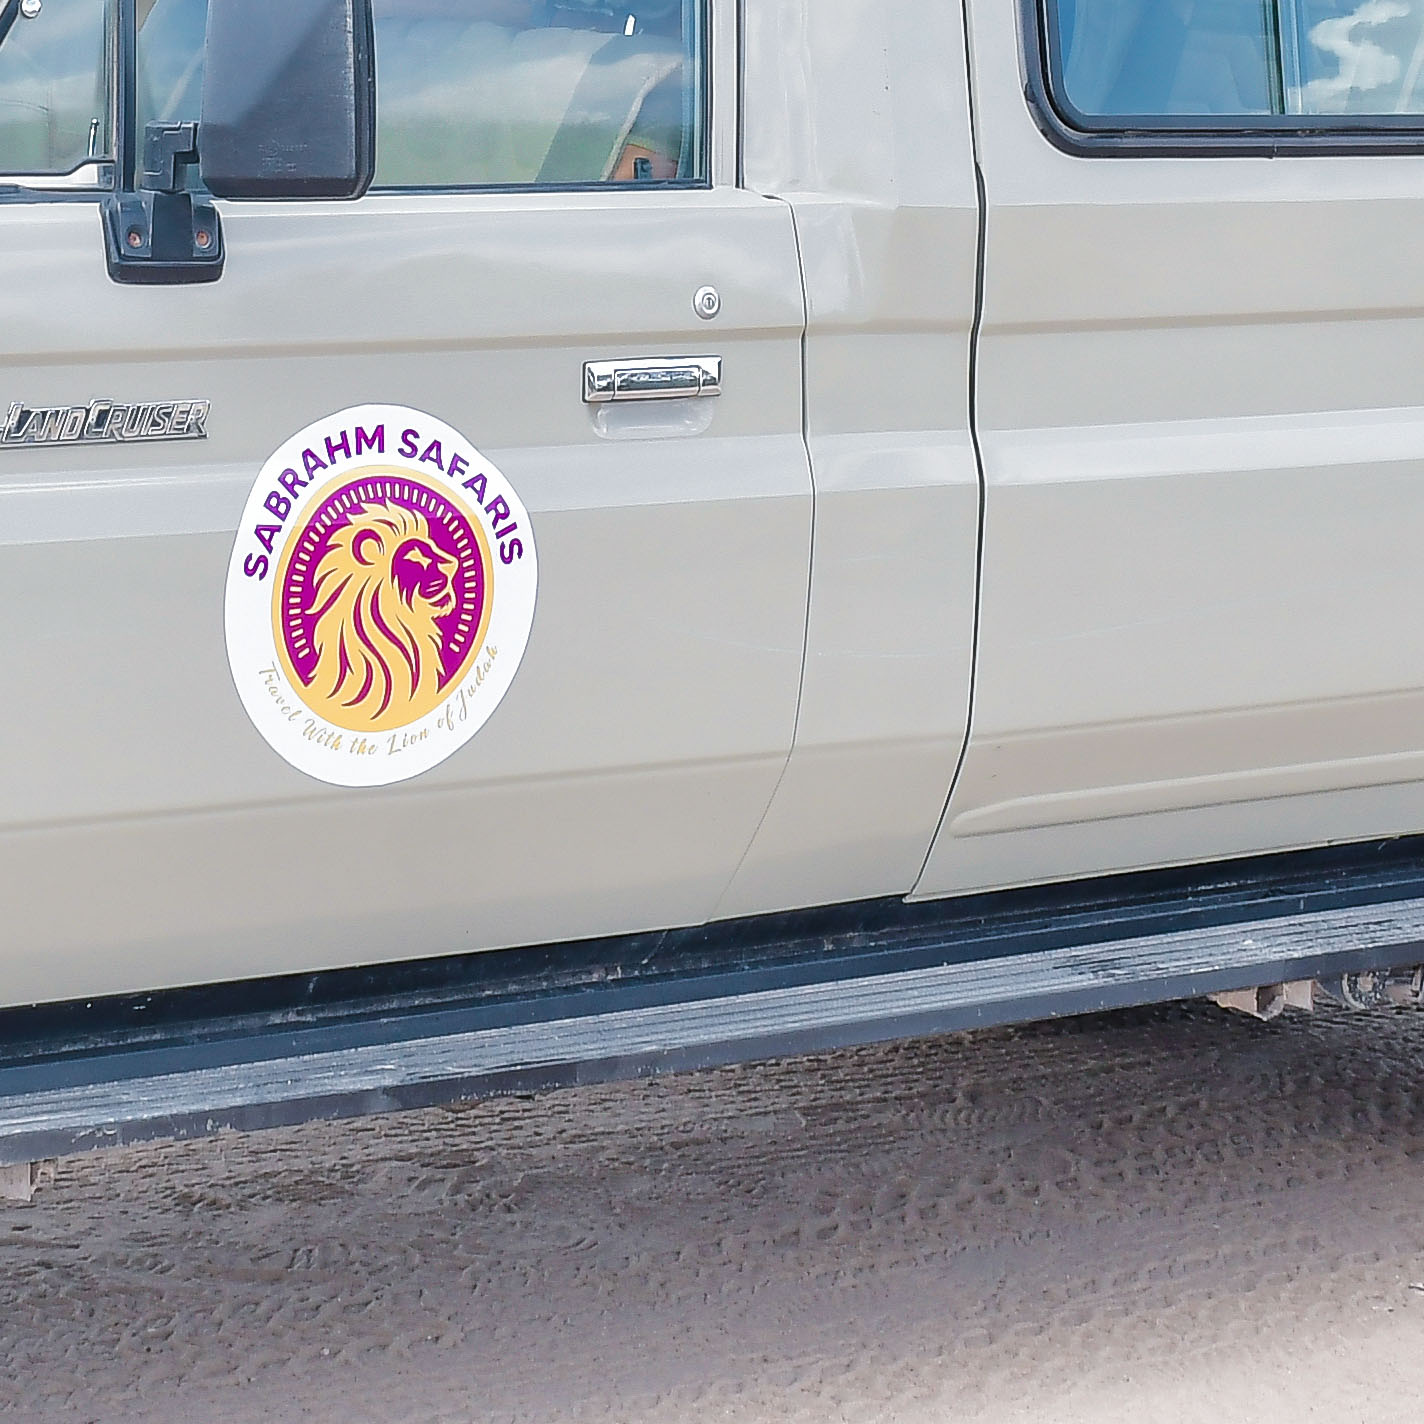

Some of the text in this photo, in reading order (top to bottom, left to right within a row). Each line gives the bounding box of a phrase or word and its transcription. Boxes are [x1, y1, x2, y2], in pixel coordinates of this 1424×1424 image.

[243, 424, 524, 582] SABRAHM SAFARIS
[259, 643, 499, 756] Travel With the Lion of Judah
